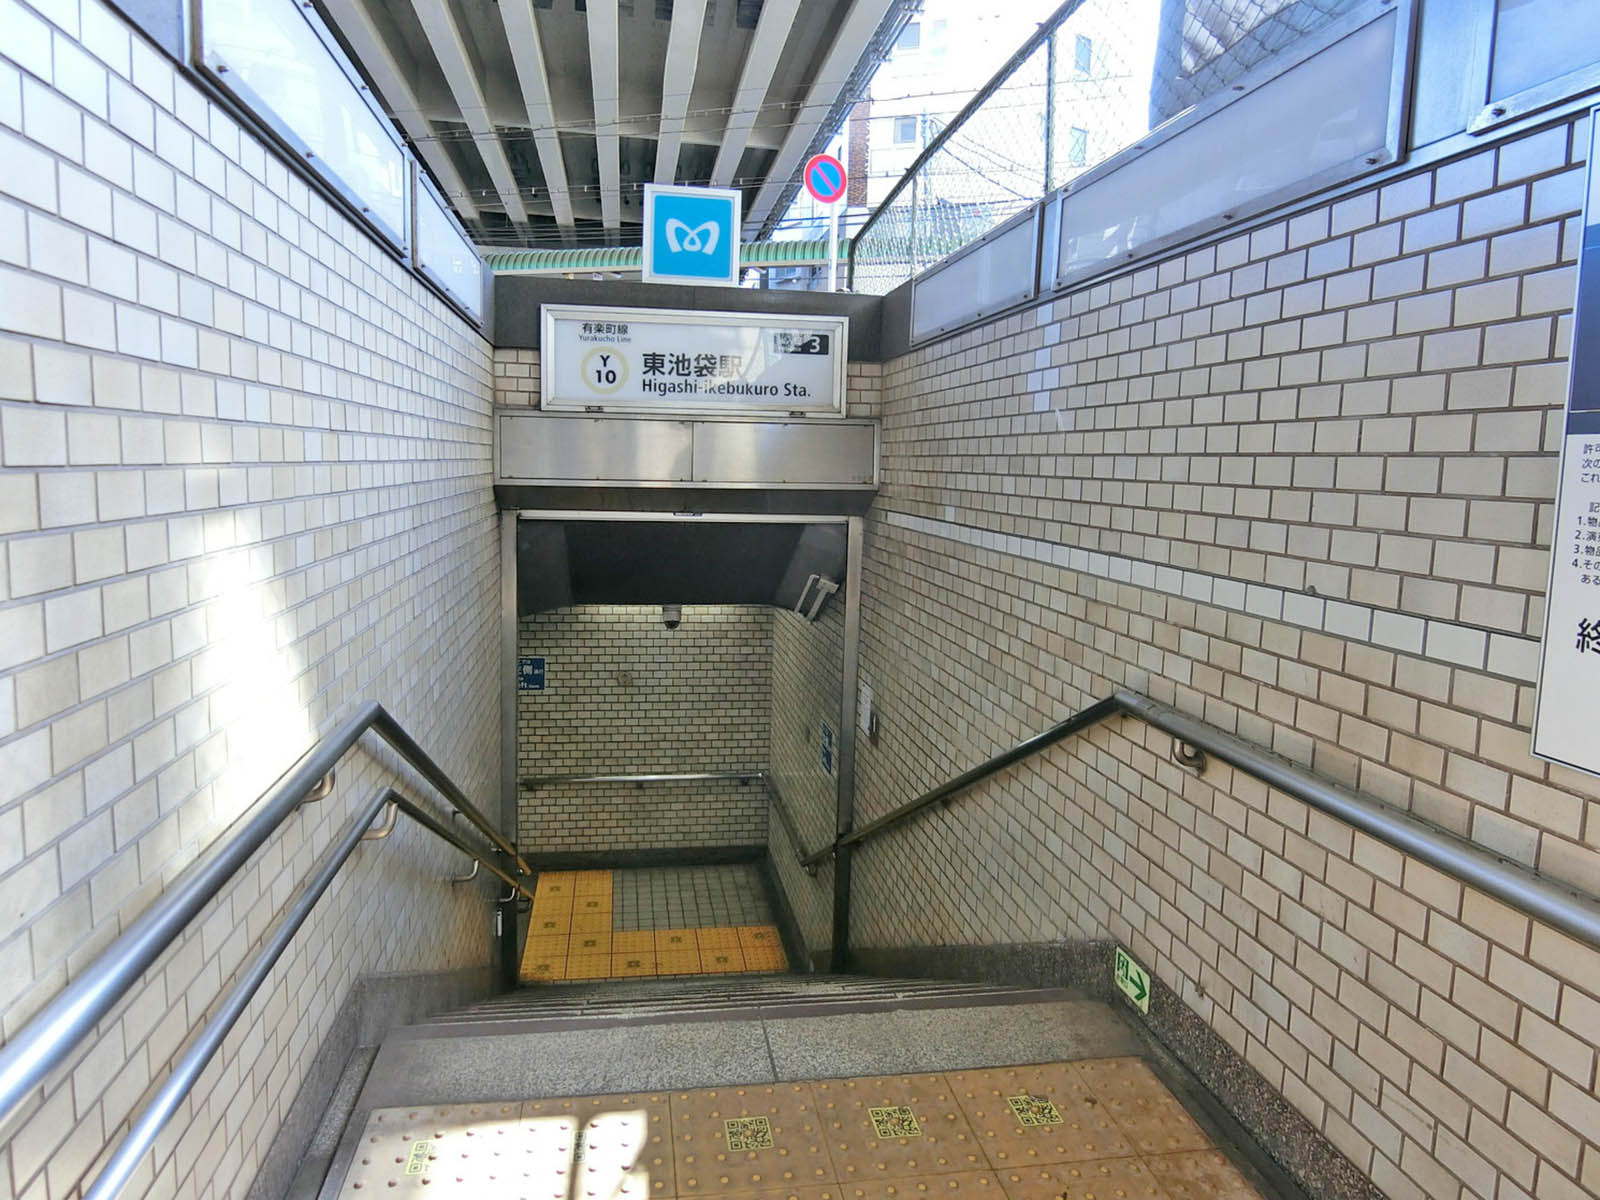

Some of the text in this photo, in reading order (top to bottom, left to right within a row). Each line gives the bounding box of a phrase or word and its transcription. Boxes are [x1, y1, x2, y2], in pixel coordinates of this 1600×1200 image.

[581, 322, 629, 335] 有楽町線
[578, 334, 632, 343] Yurakucho Line
[809, 336, 820, 353] 3
[599, 354, 611, 367] Y
[642, 351, 743, 378] 東池袋駅
[595, 369, 617, 384] 10
[642, 378, 811, 397] Higashi-ikebukuro Sta.
